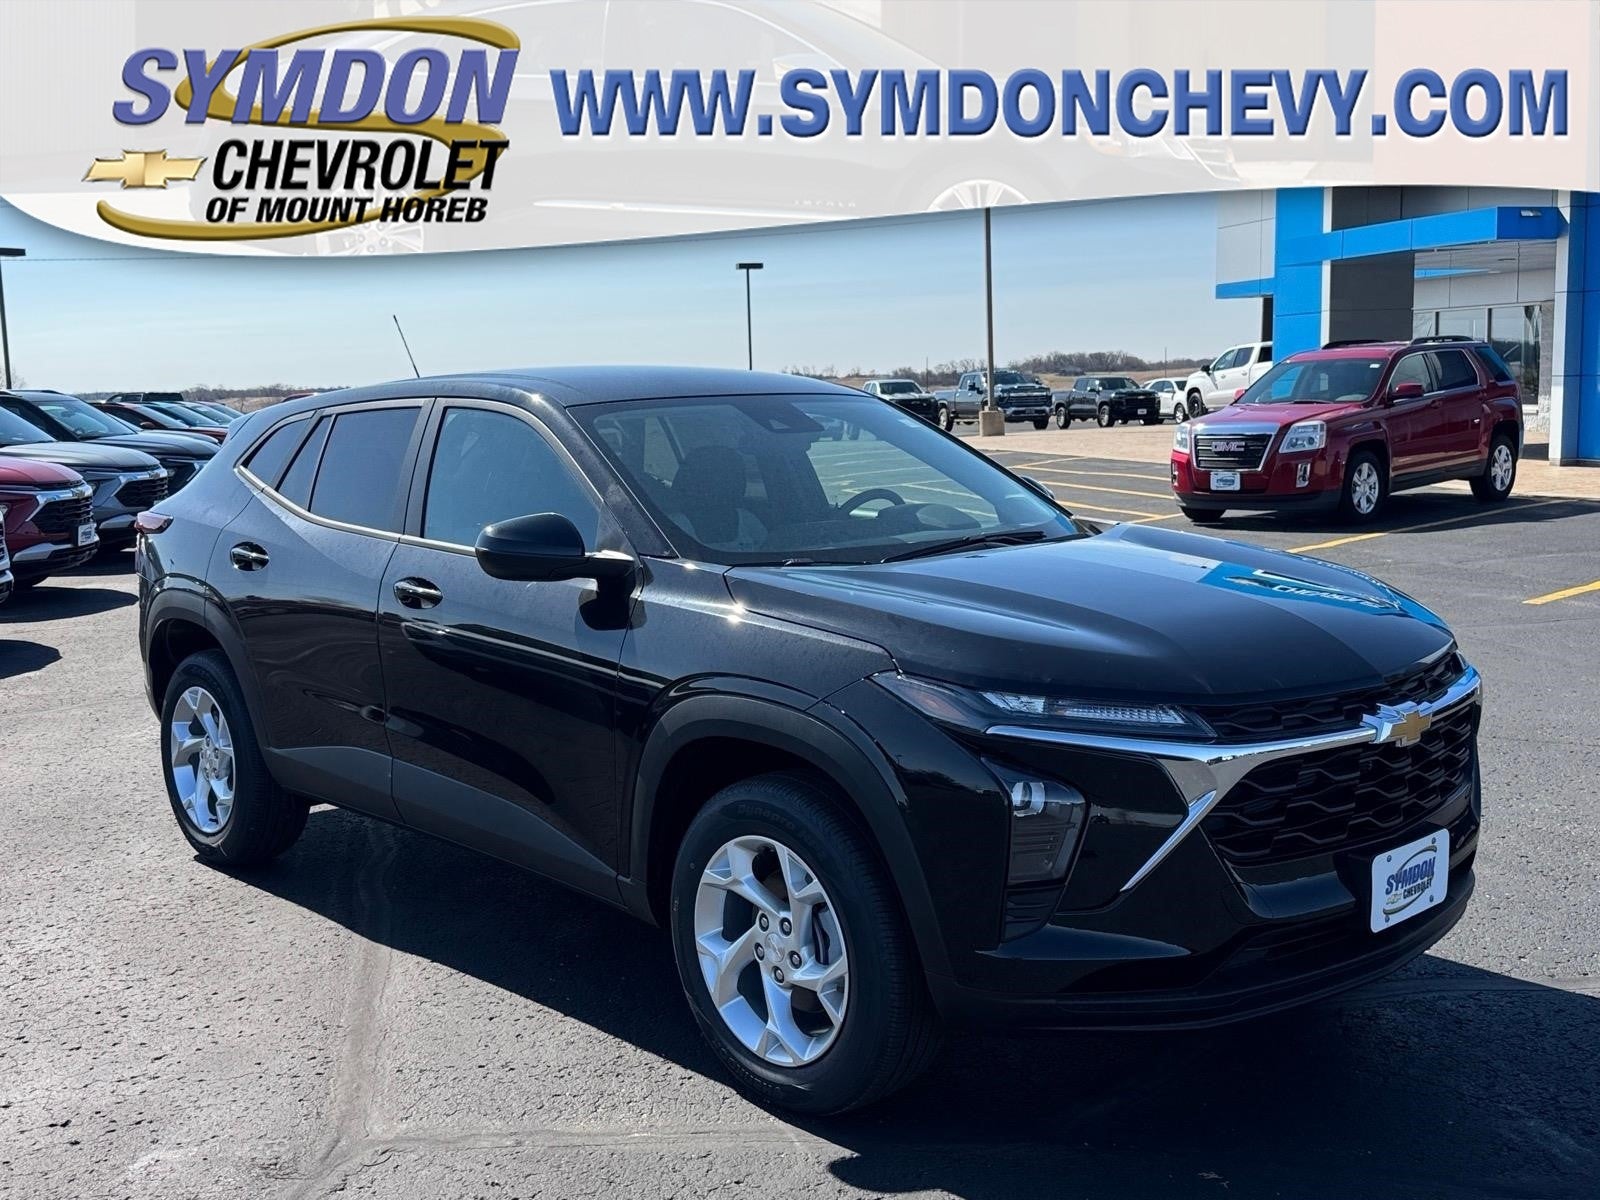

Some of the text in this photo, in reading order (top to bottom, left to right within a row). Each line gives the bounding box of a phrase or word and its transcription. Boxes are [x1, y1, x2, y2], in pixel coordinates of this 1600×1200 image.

[1212, 441, 1245, 452] GMC
[1385, 857, 1436, 895] SYMDON
[1403, 877, 1432, 899] CHEVROLET
